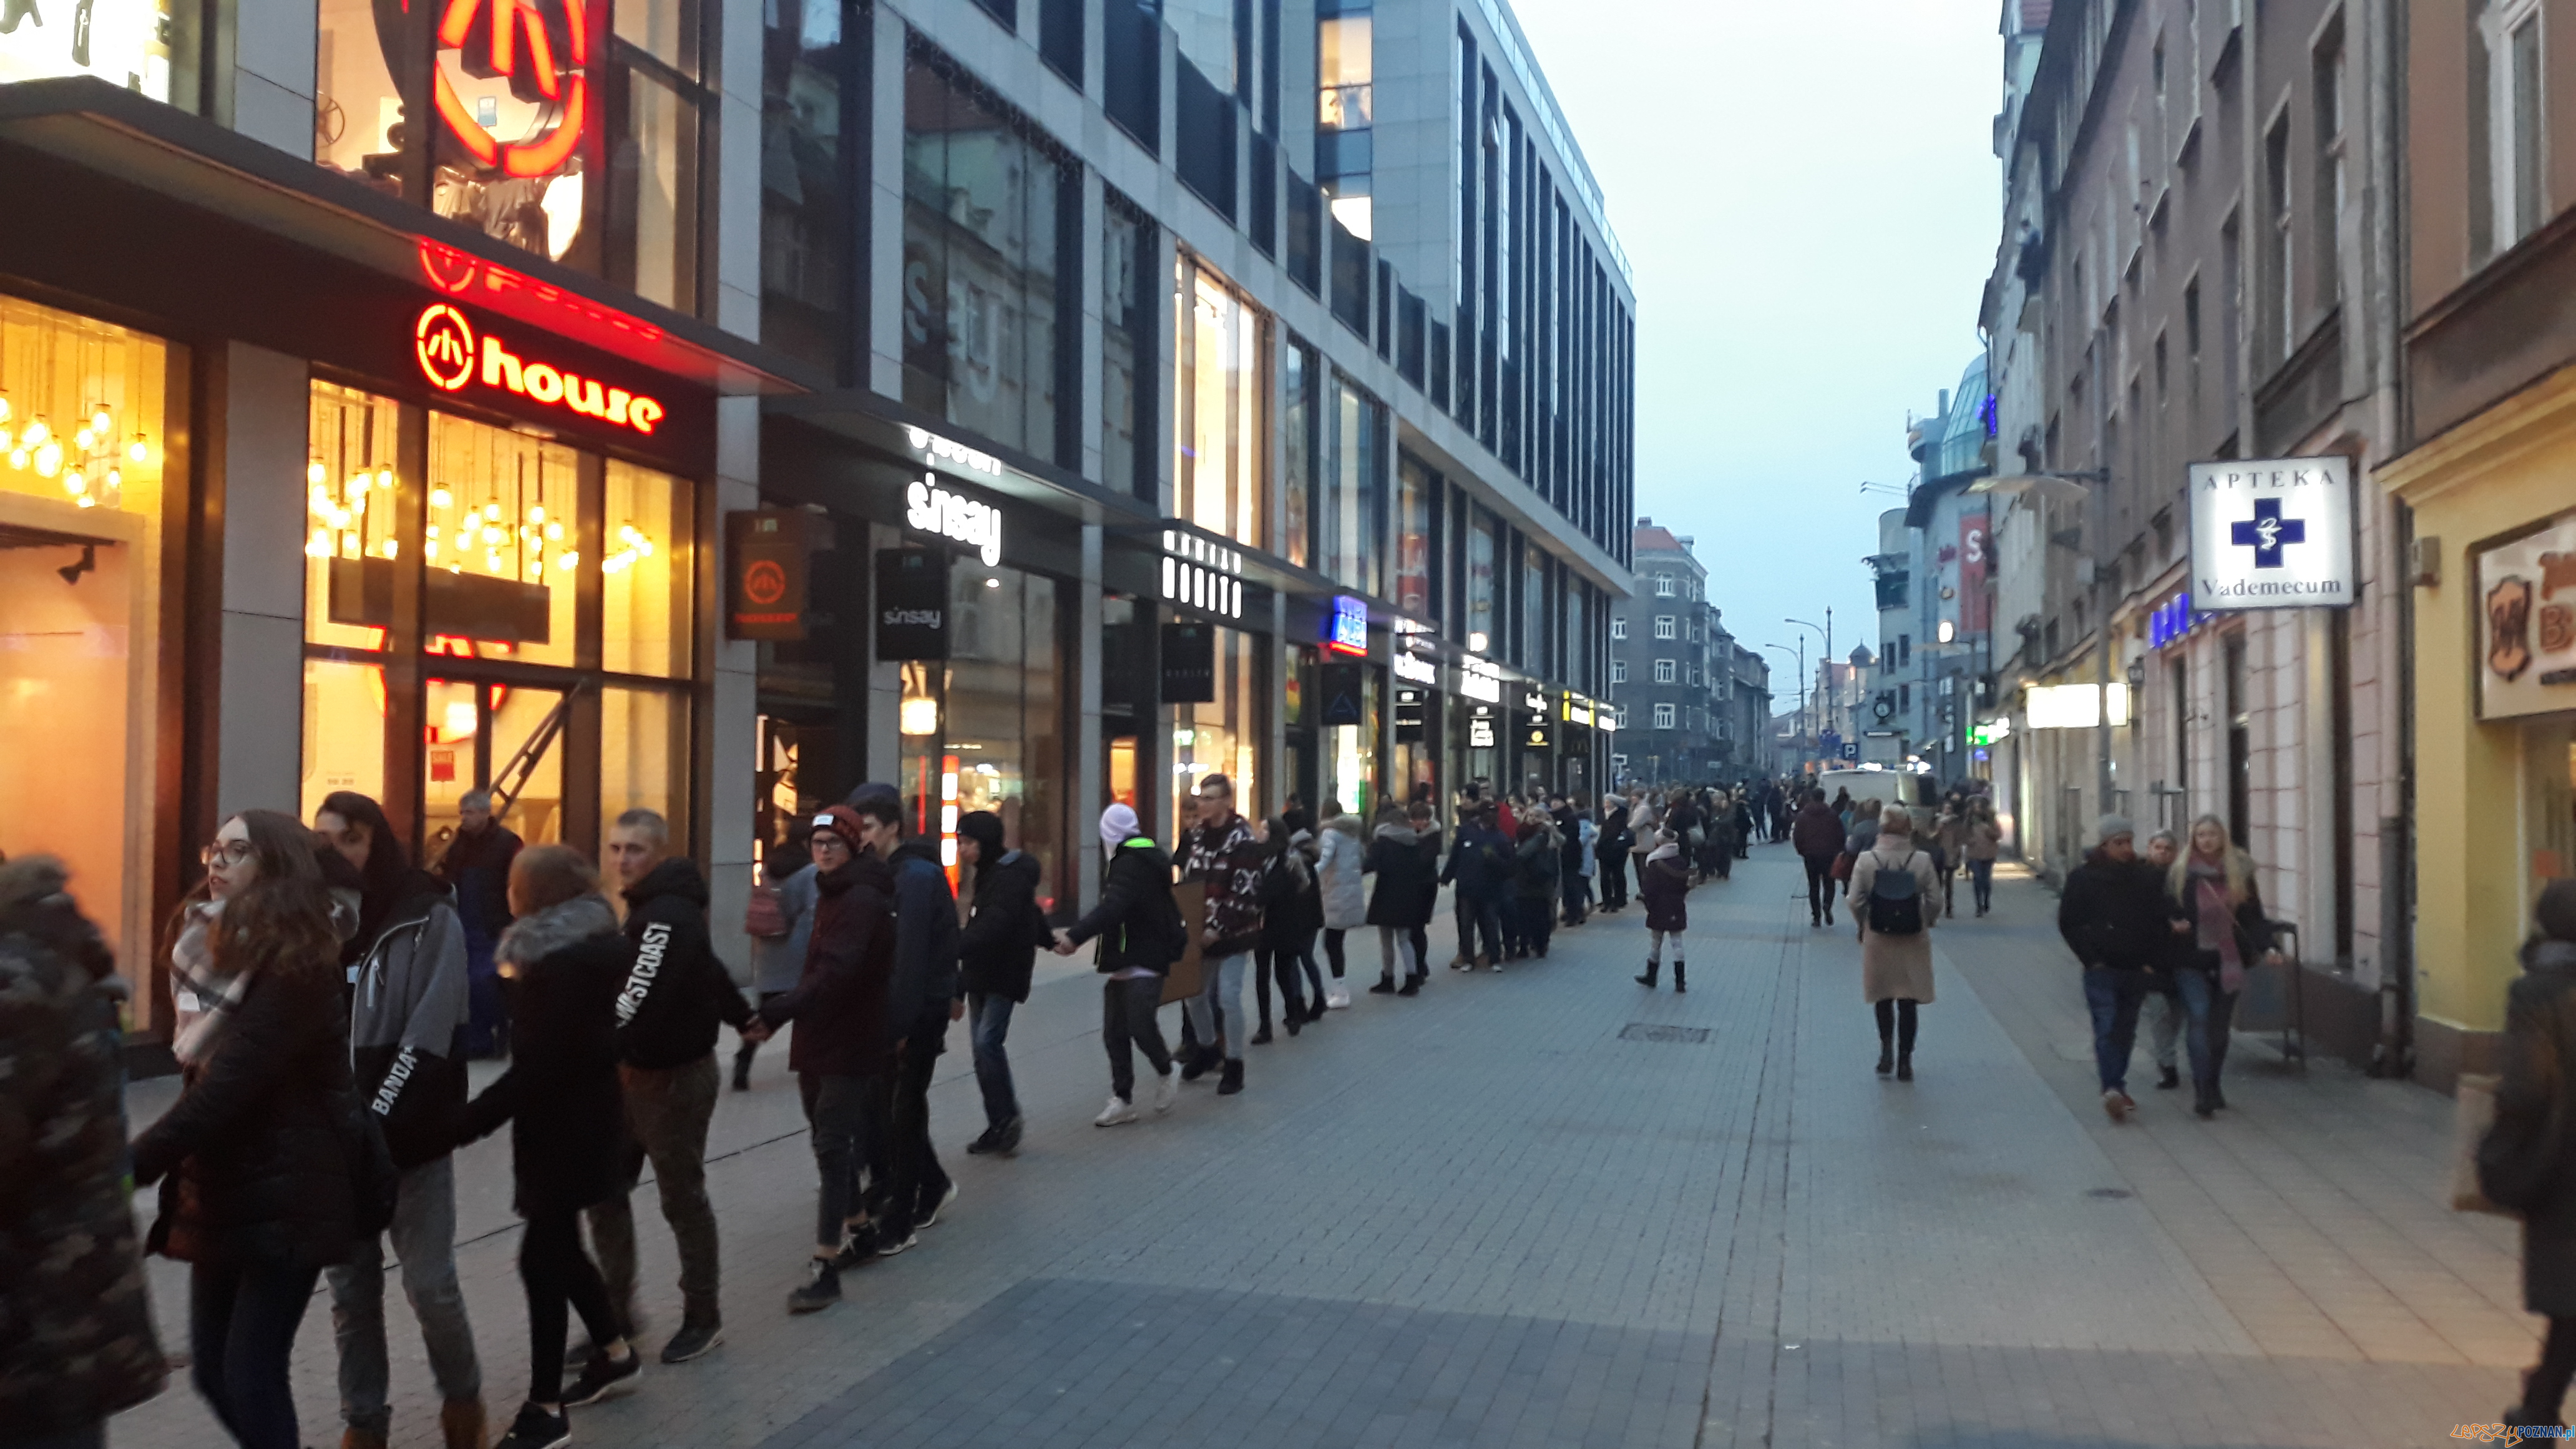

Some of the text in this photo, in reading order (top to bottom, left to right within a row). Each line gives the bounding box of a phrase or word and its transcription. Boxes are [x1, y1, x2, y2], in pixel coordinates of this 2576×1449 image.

[482, 336, 665, 434] house
[2203, 469, 2335, 490] APTEKA
[2202, 578, 2341, 597] Vademecum
[883, 607, 942, 630] sinsay
